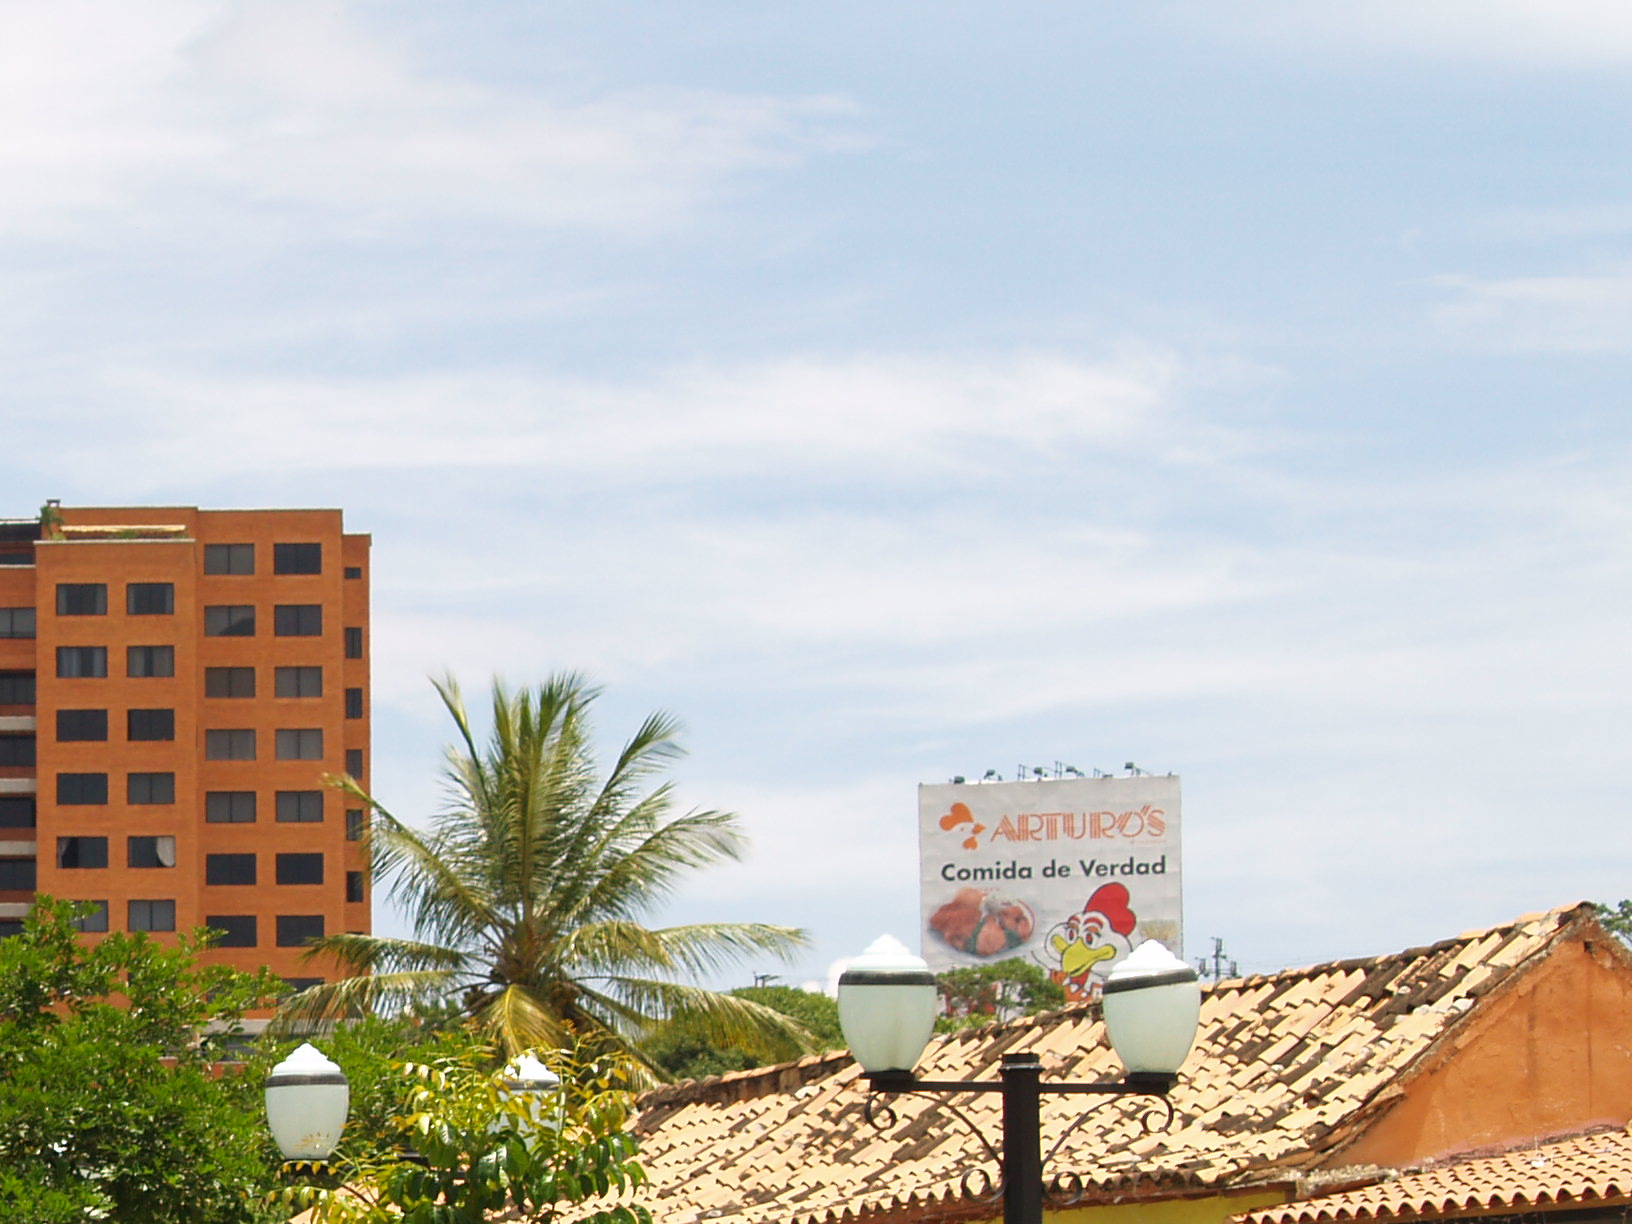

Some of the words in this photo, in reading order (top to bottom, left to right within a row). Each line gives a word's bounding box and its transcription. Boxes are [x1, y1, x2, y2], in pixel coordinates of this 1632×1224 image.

[990, 804, 1166, 842] ARTURO'S
[940, 860, 1033, 882] Comida
[1042, 859, 1071, 878] de
[1079, 855, 1167, 877] Verdad
